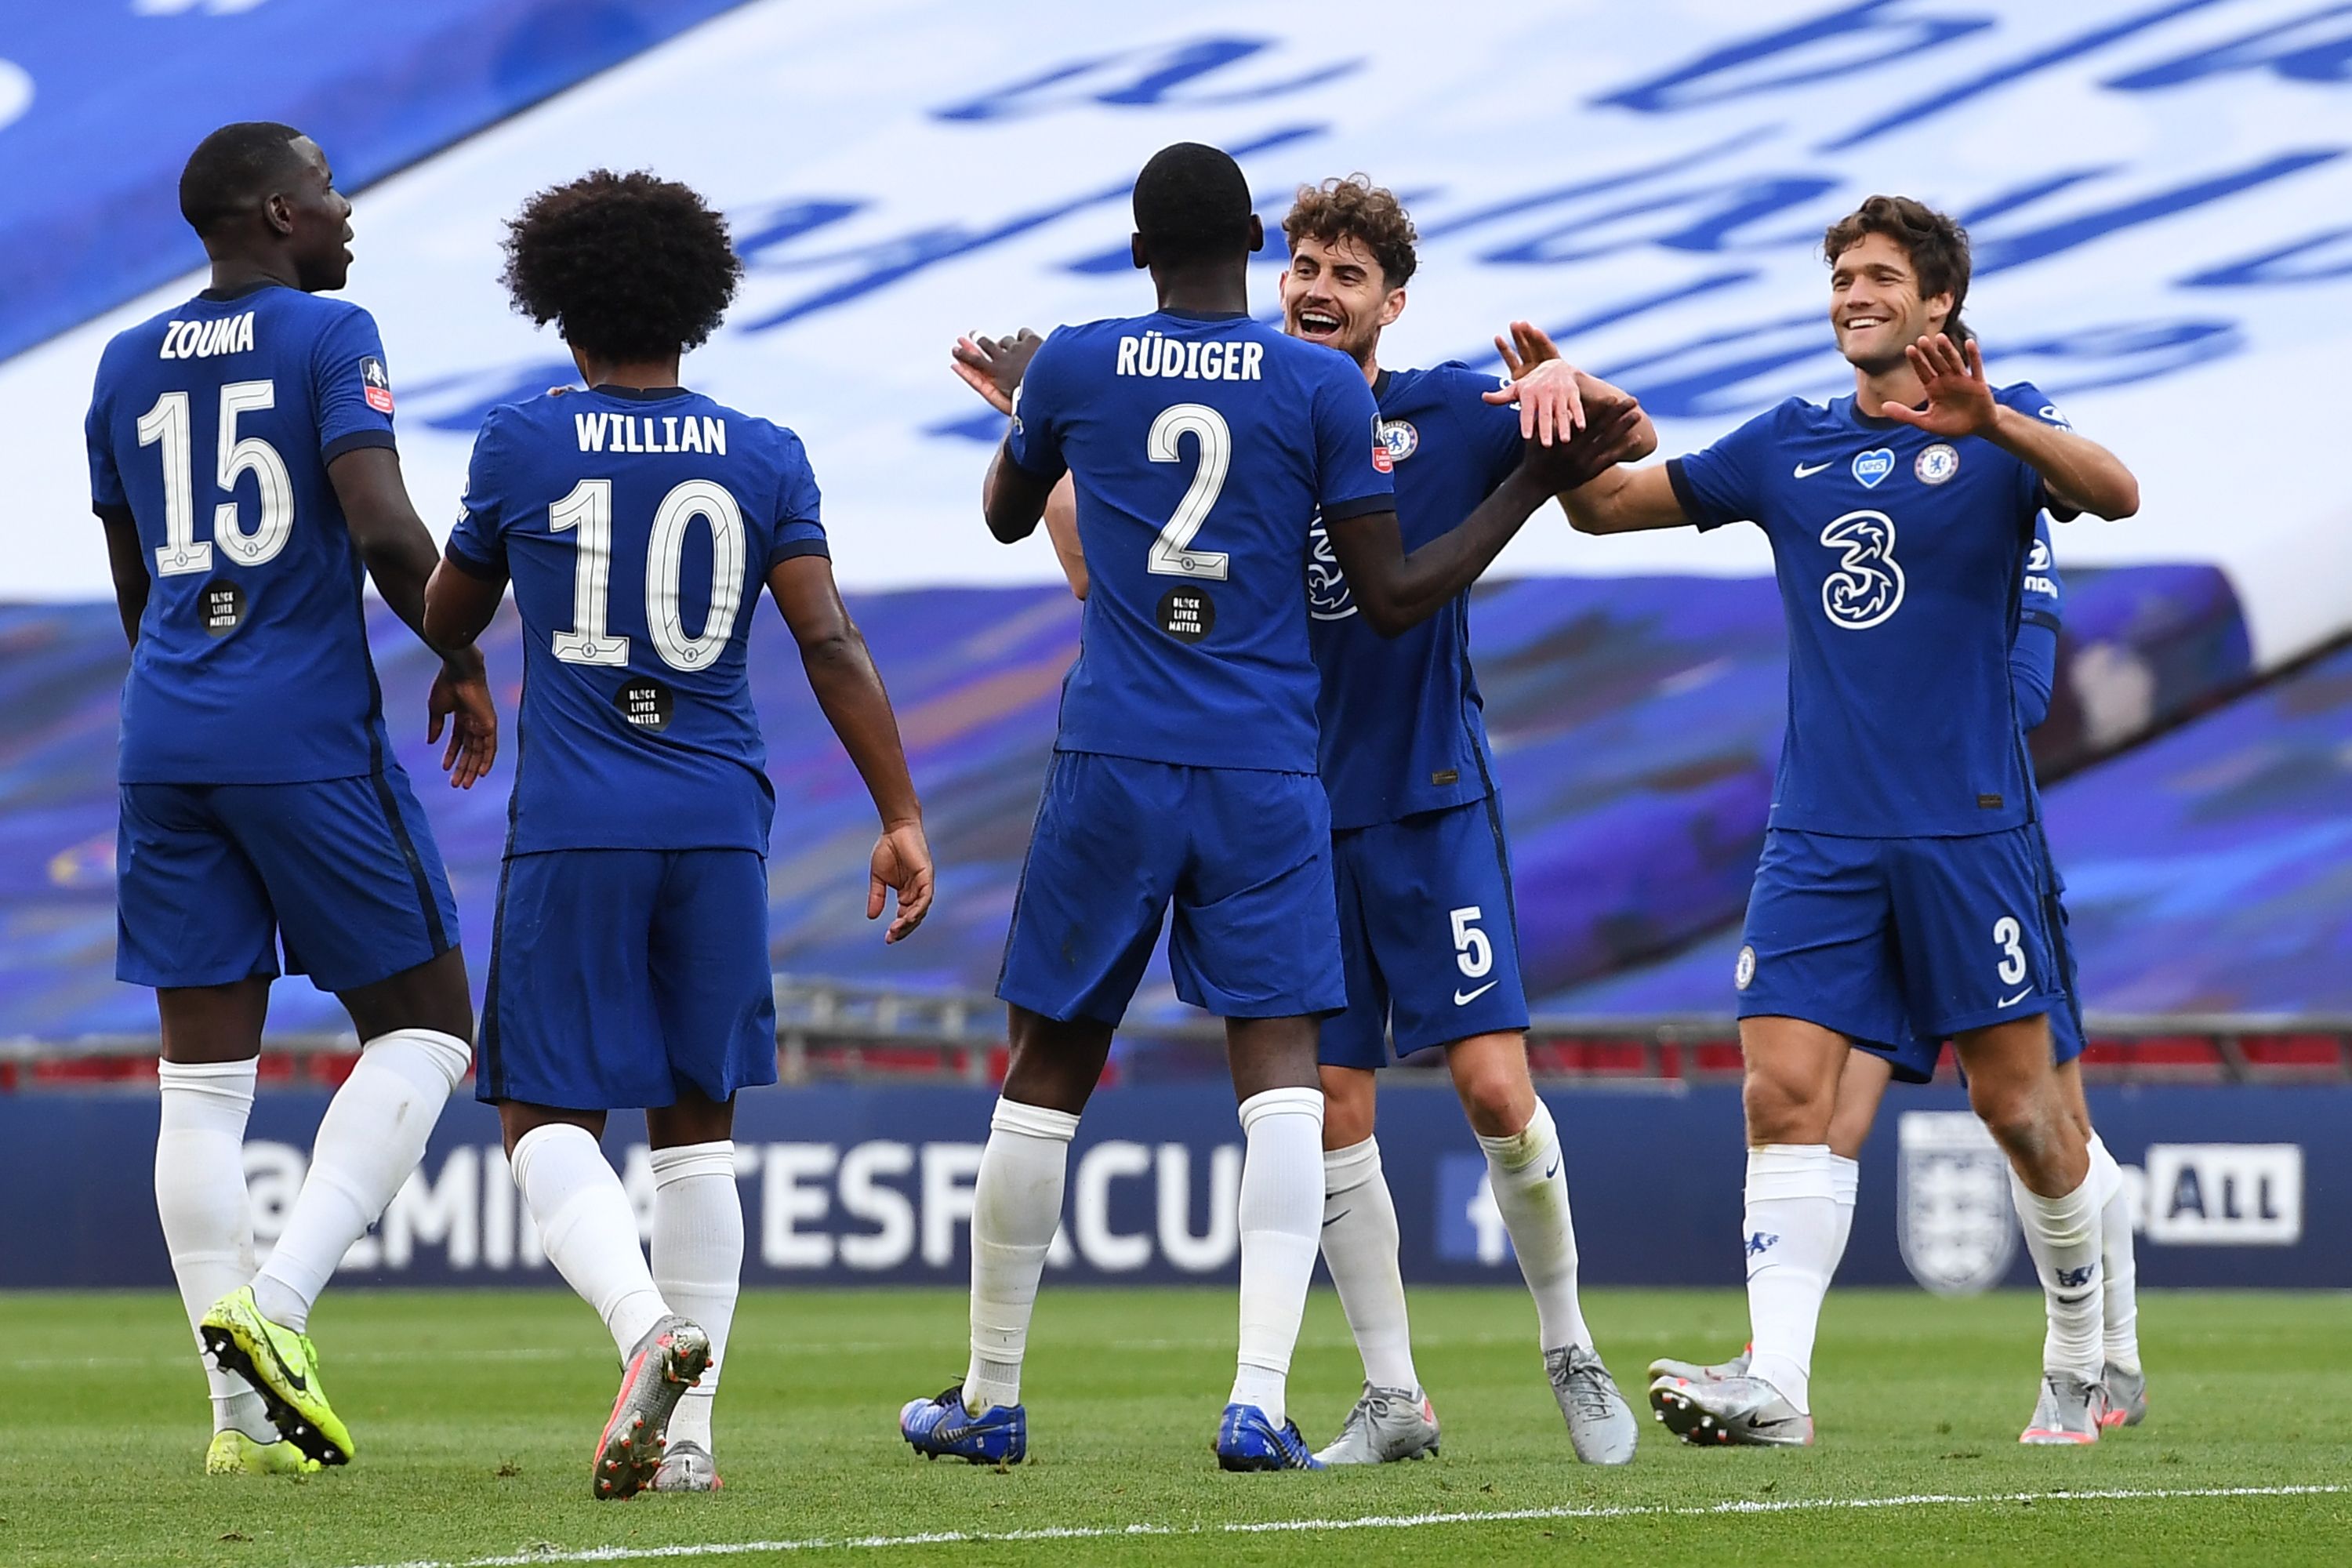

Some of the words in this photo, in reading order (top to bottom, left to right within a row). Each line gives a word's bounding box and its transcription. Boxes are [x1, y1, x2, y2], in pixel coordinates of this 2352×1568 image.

[160, 312, 255, 359] ZOUMA
[1116, 330, 1264, 380] RÜDIGER
[575, 412, 726, 456] WILLIAN
[137, 379, 295, 578] 15
[1861, 459, 1885, 472] NHS
[1147, 403, 1231, 581] 2
[549, 479, 746, 672] 10
[210, 615, 236, 626] MATTER
[212, 603, 233, 615] LIVES
[1168, 621, 1201, 633] MATTER
[1174, 609, 1198, 621] LIVES
[627, 713, 660, 724] MATTER
[631, 701, 655, 713] LIVES
[1450, 906, 1493, 978] 5
[1993, 916, 2026, 985] 3
